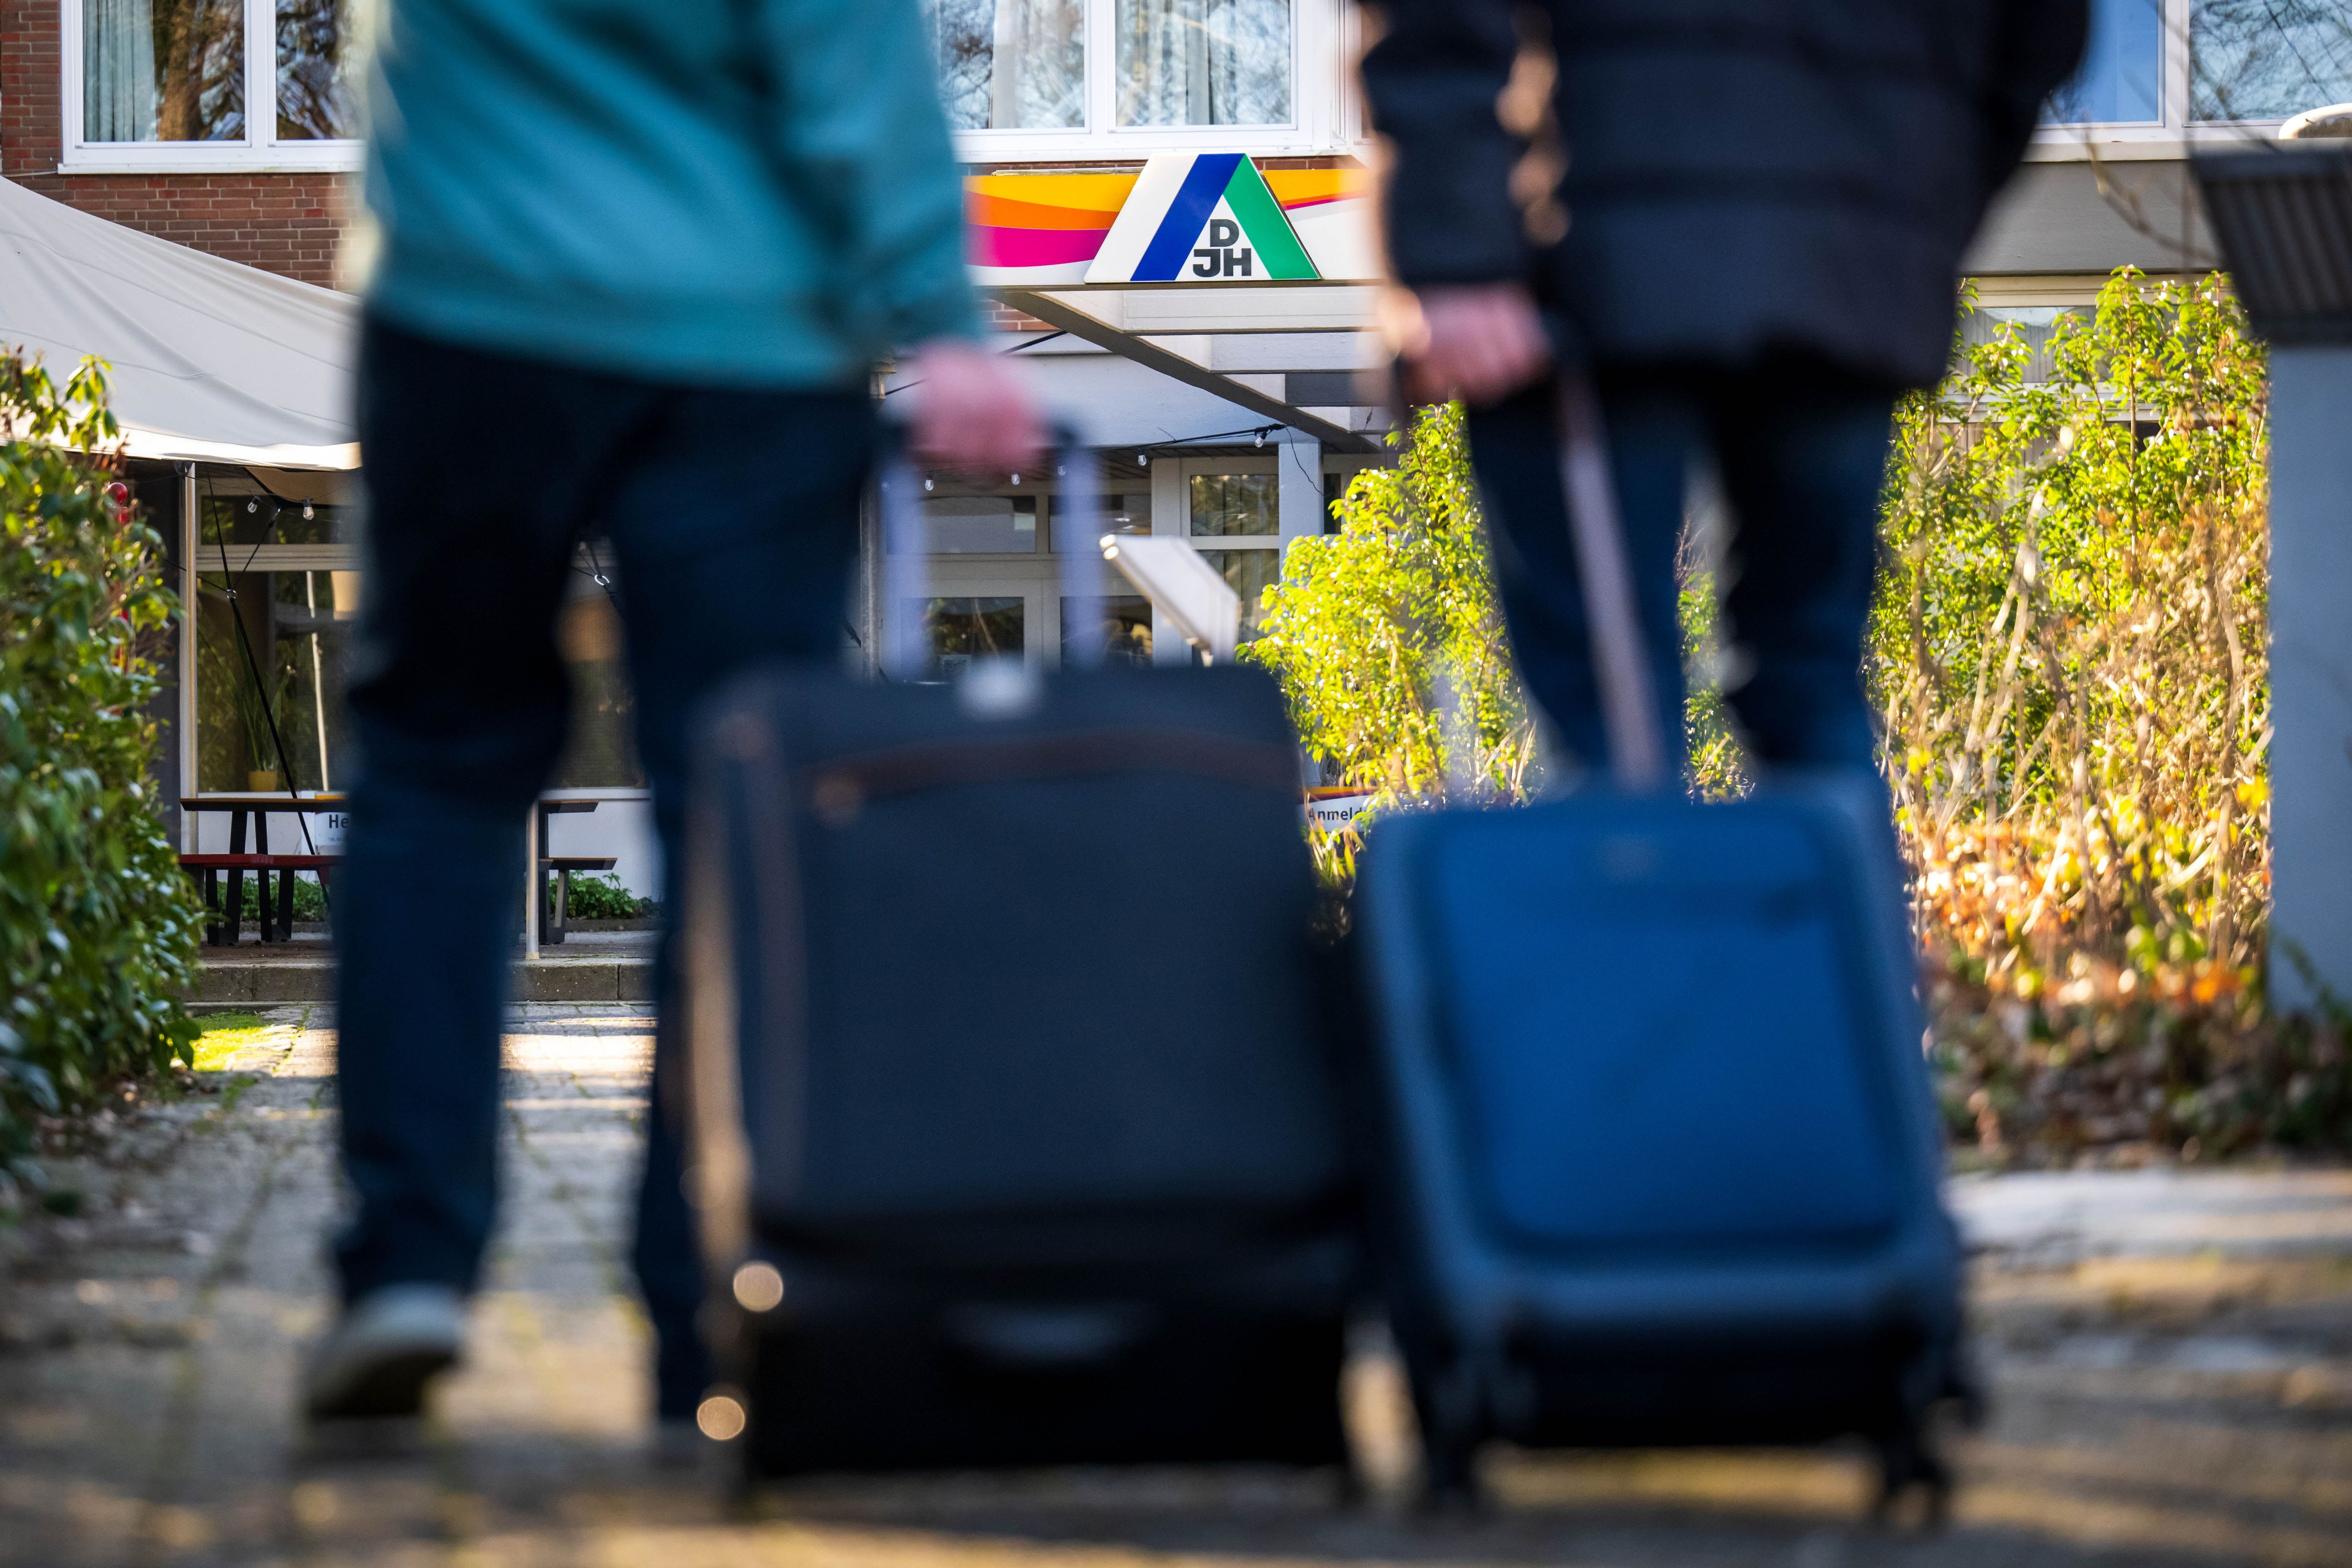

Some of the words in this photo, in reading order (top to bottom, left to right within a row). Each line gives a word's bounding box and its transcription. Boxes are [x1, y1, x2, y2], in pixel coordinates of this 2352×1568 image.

[1210, 219, 1239, 247] D
[1193, 248, 1252, 278] JH
[1308, 807, 1366, 820] Anmeld
